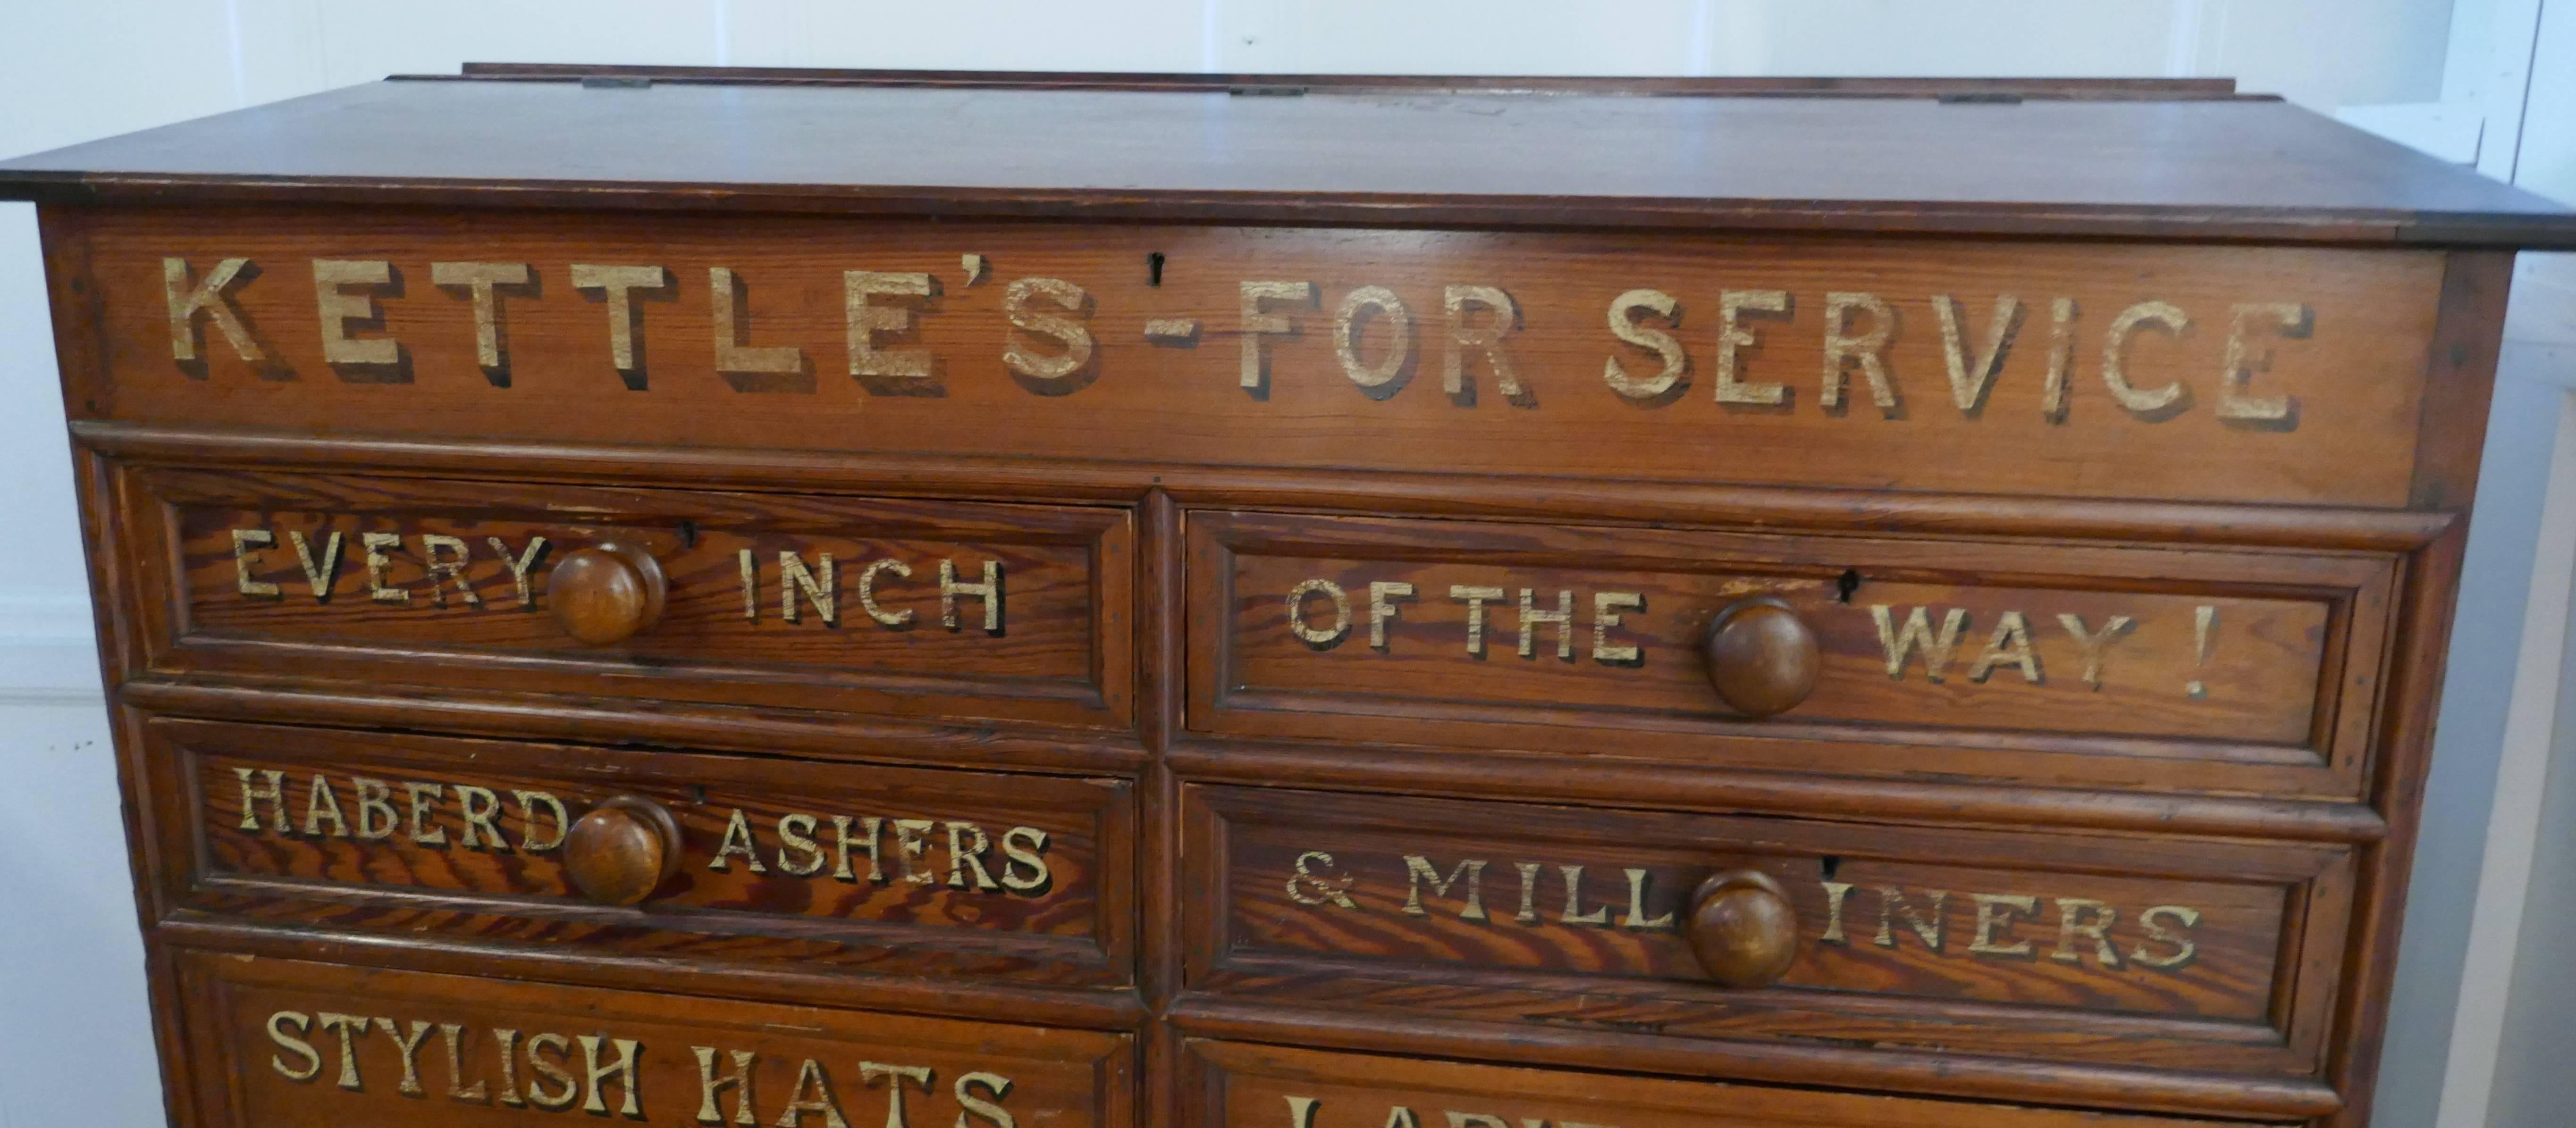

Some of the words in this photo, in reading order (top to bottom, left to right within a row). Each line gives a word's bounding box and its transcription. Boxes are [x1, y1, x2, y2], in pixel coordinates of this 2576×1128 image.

[162, 253, 1094, 381] KETTLE'S
[1237, 280, 1524, 400] FOR
[1604, 289, 2307, 422] SERVICE
[231, 528, 547, 605] EVERY
[740, 547, 1003, 631] INCH
[1286, 577, 1414, 649] OF
[1449, 585, 1645, 660] THE
[1871, 604, 2131, 683] WAY
[233, 766, 568, 852] HABERD
[708, 809, 1051, 890] ASHERS
[1286, 851, 1356, 909] &
[1401, 854, 1675, 927] MILL
[1821, 881, 2199, 967] INERS
[266, 1011, 644, 1114] STYLISH
[691, 1044, 1015, 1128] HATS
